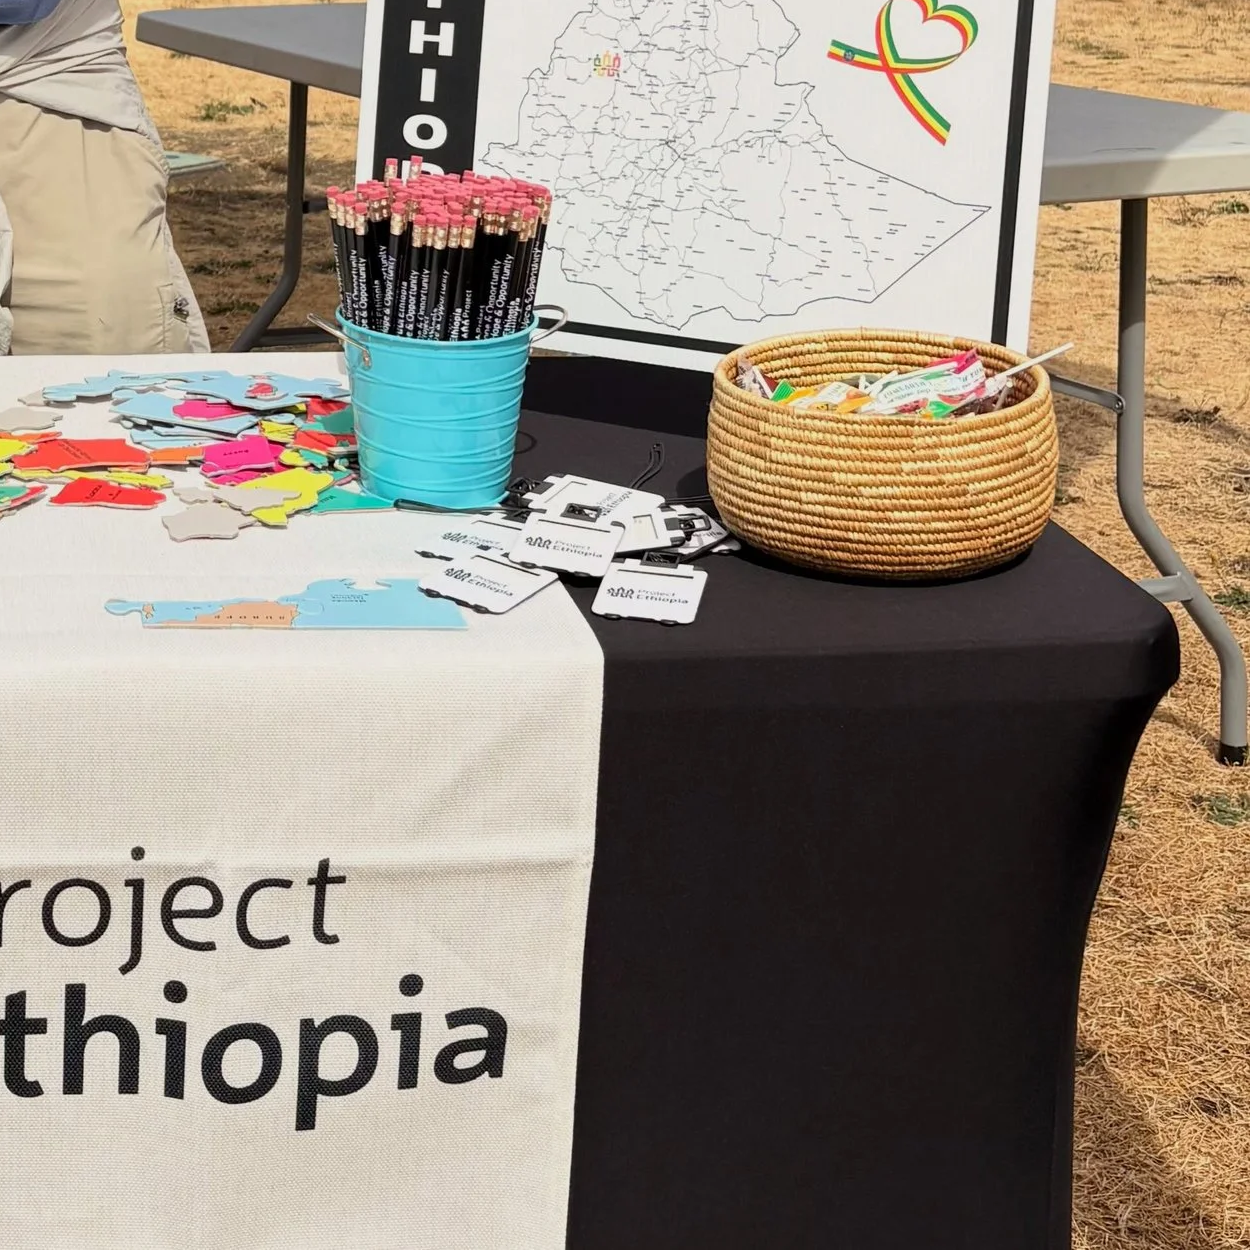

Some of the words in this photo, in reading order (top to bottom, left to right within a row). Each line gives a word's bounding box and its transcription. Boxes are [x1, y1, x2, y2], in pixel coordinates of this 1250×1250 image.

[358, 257, 368, 309] Opportunity
[383, 255, 397, 307] Opportunity
[406, 269, 420, 323] Opportunity
[496, 253, 515, 308] Opportunity
[494, 309, 503, 317] &
[552, 545, 603, 558] Ethiopia
[467, 576, 514, 597] Ethiopia
[636, 594, 689, 605] Ethiopia
